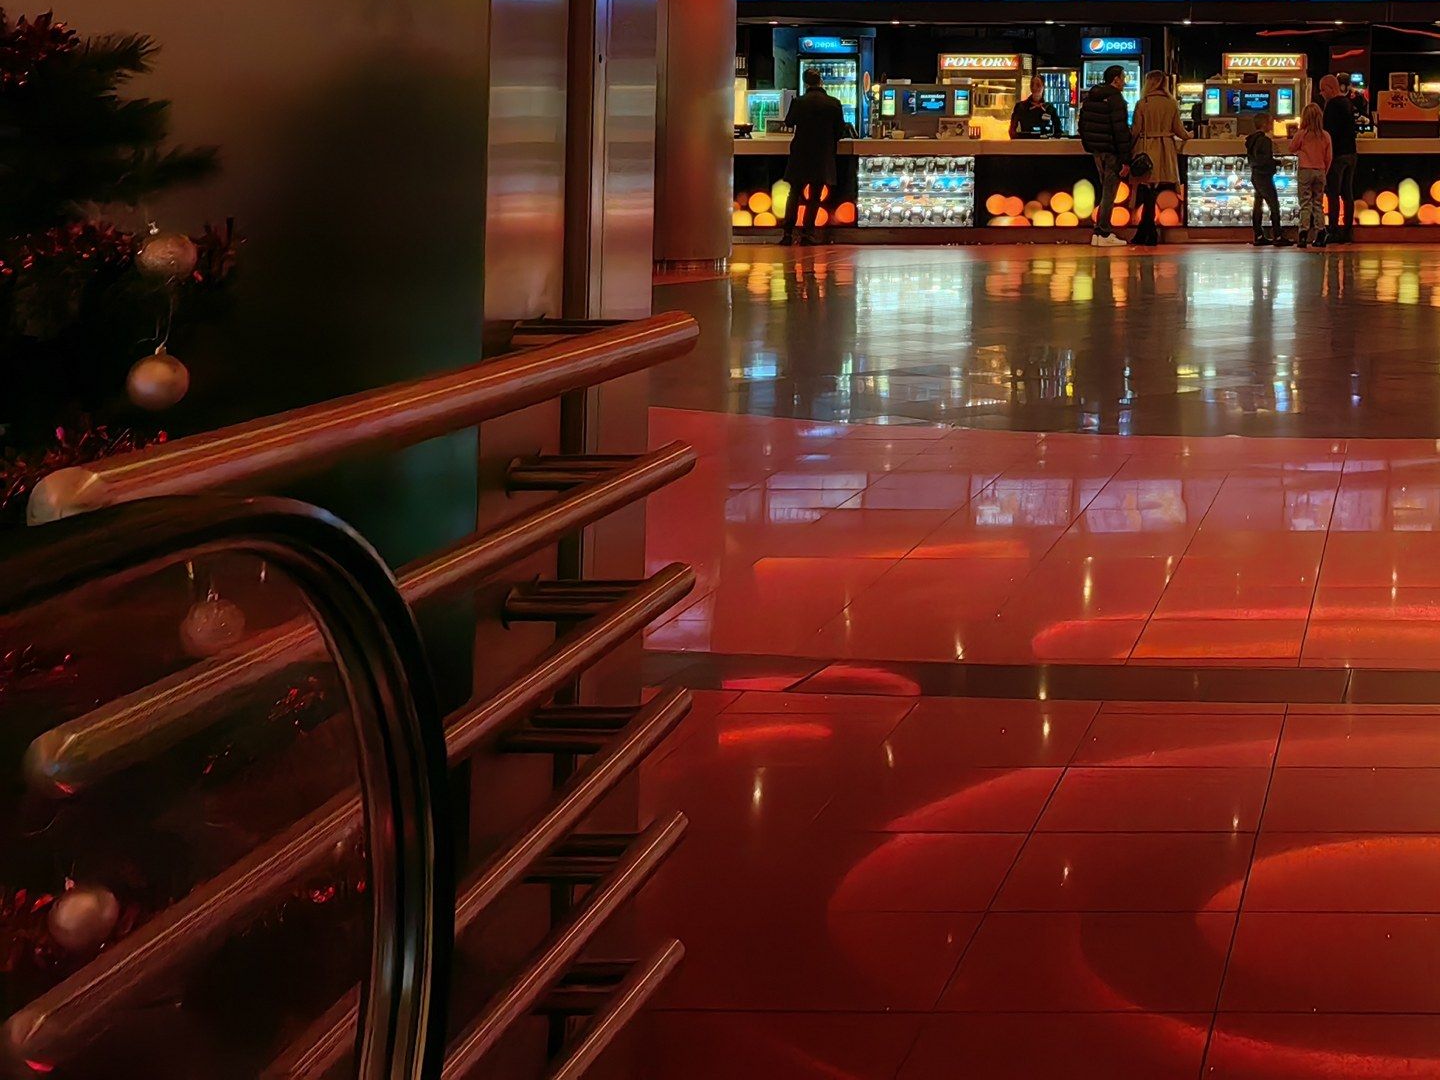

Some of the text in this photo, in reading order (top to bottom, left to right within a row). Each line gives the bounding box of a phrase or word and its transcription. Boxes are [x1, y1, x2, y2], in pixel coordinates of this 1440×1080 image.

[1106, 40, 1136, 51] pepsi
[944, 57, 1013, 67] POPCORN
[1229, 57, 1297, 67] POPCORN
